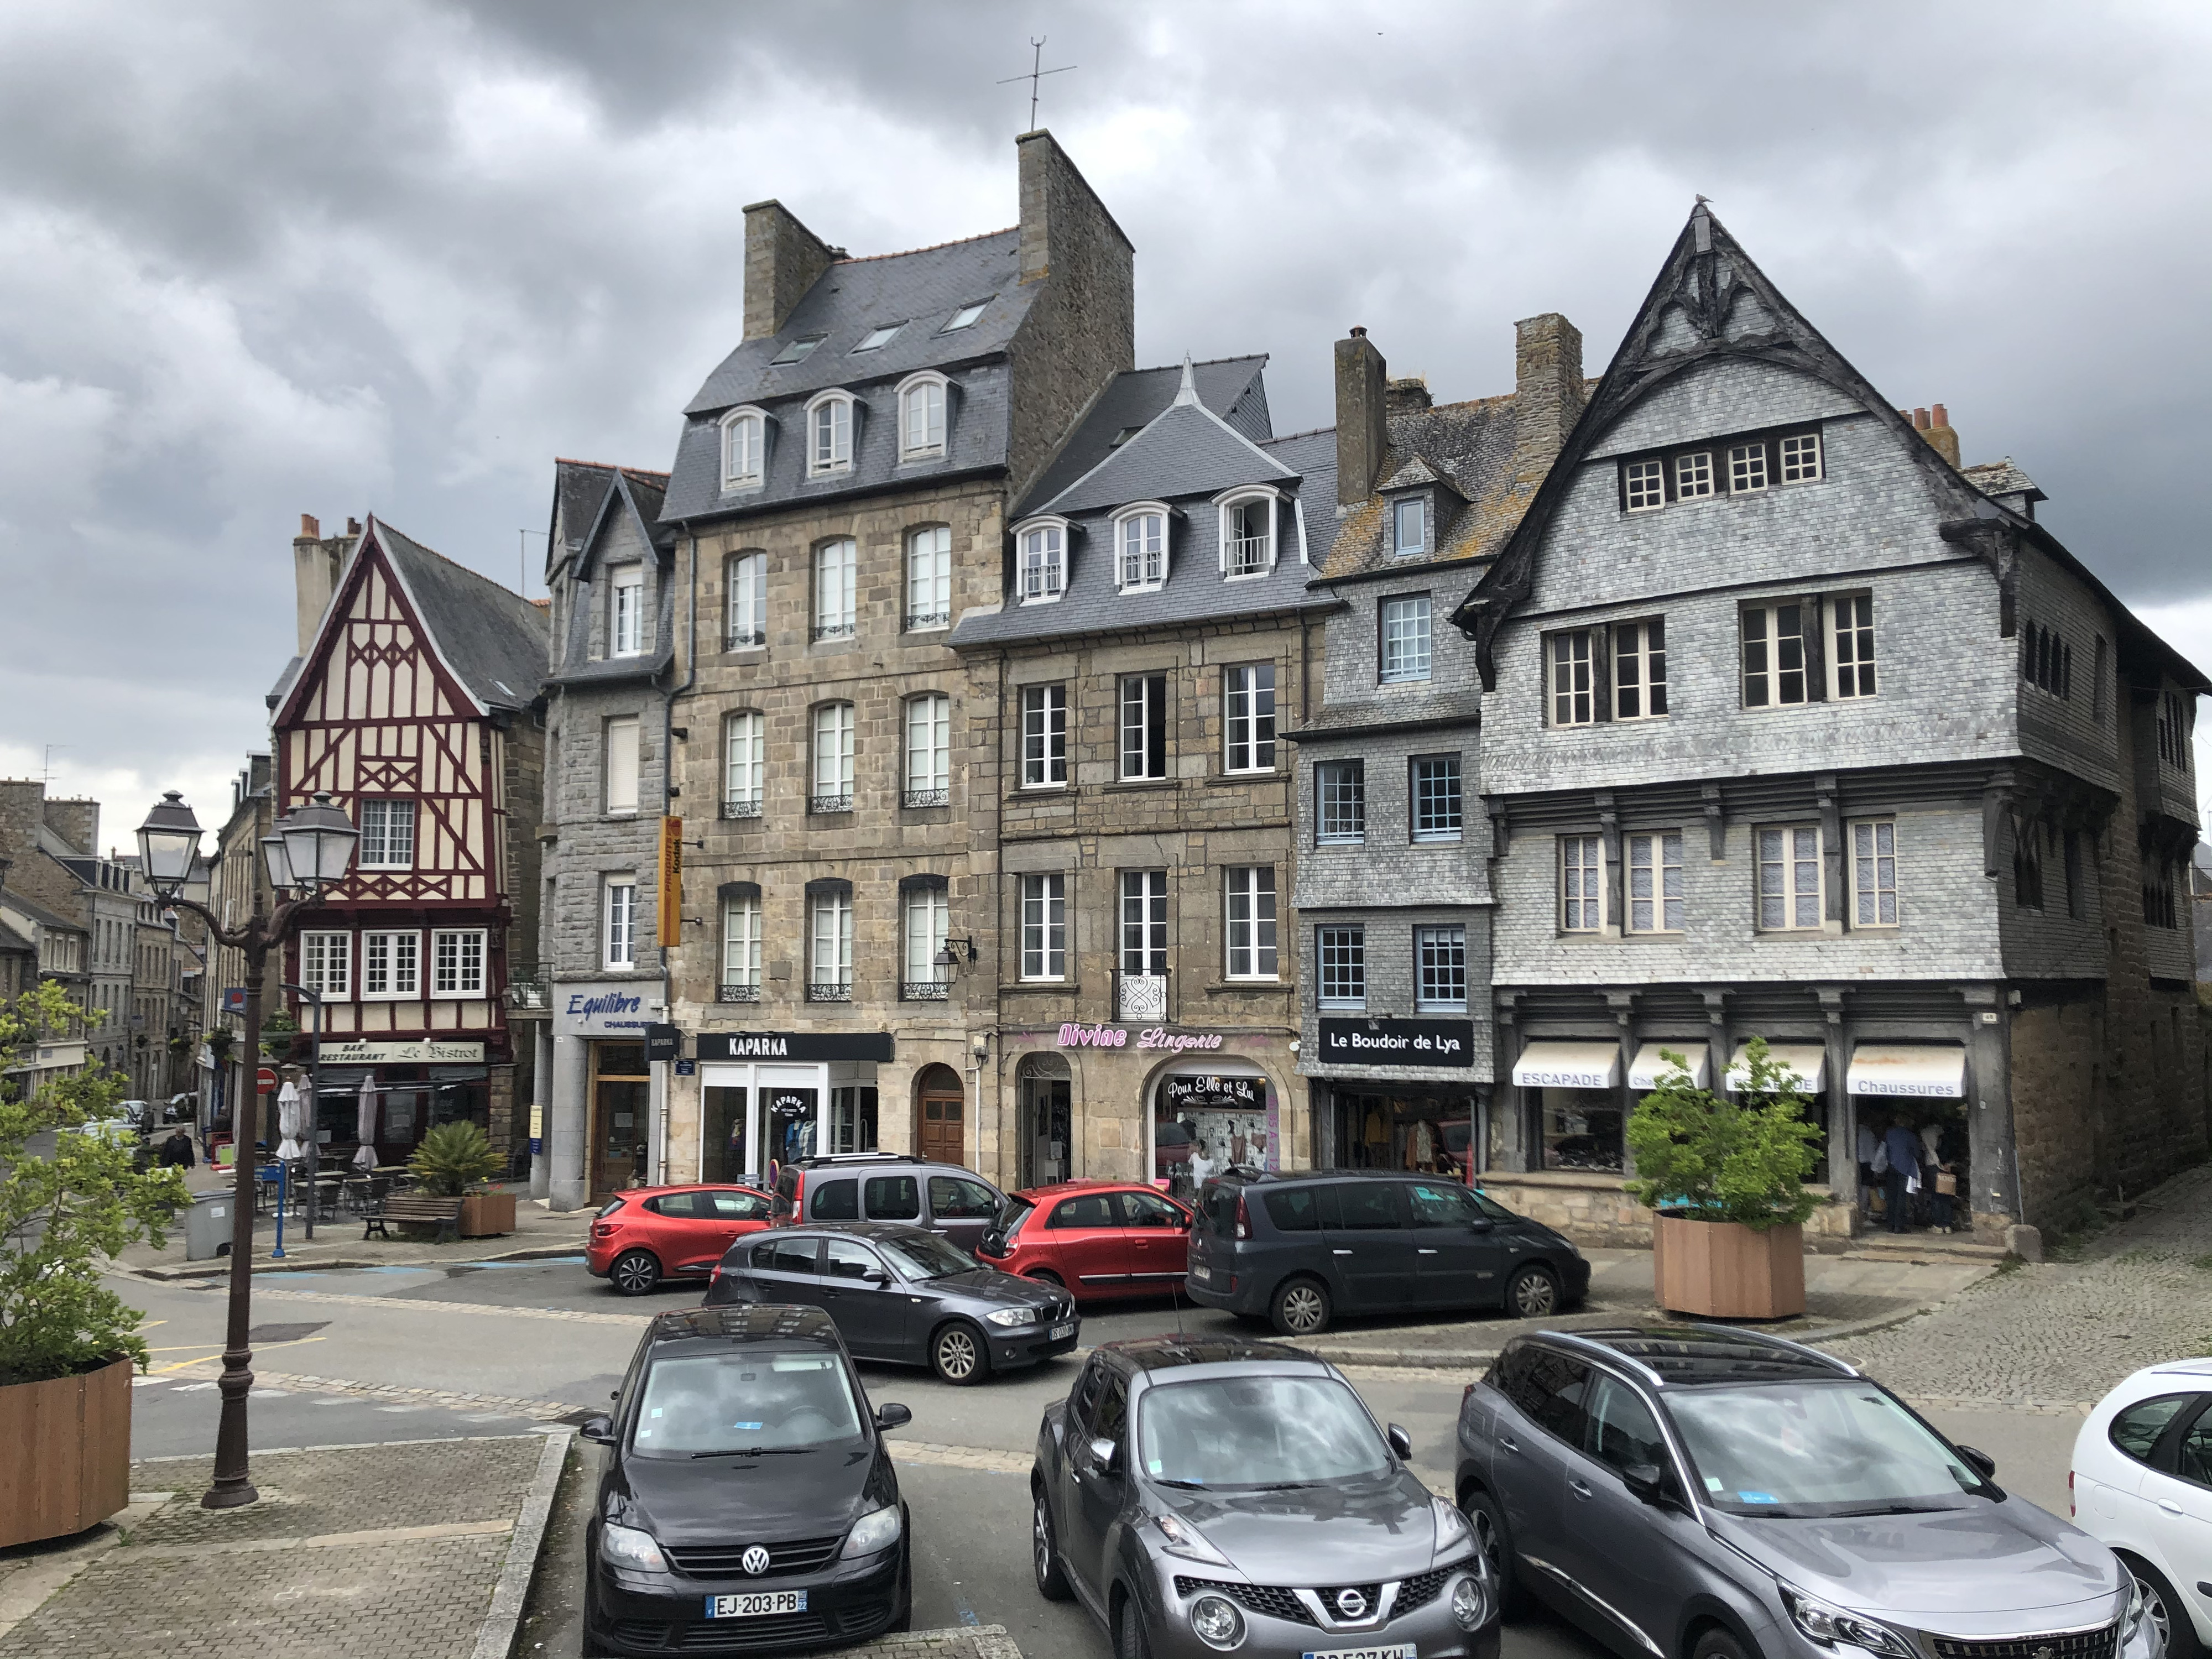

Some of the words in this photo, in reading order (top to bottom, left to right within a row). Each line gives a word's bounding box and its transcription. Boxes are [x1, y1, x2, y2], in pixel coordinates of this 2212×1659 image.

[566, 992, 640, 1021] Equilibre
[729, 1038, 787, 1056] KAPARKA
[1057, 1024, 1127, 1046] Divine
[1136, 1027, 1222, 1053] Lingerie
[1331, 1032, 1348, 1047] Le
[1352, 1032, 1410, 1049] Boudoir
[1413, 1034, 1432, 1050] de
[1436, 1034, 1461, 1055] Lya
[1167, 1082, 1192, 1098] Pour
[1195, 1076, 1220, 1093] Elle
[1223, 1081, 1233, 1094] et
[1235, 1081, 1255, 1102] Lui
[1522, 1072, 1602, 1086] ESCAPADE
[1858, 1080, 1954, 1095] Chaussures
[770, 1095, 807, 1114] KAPARKA
